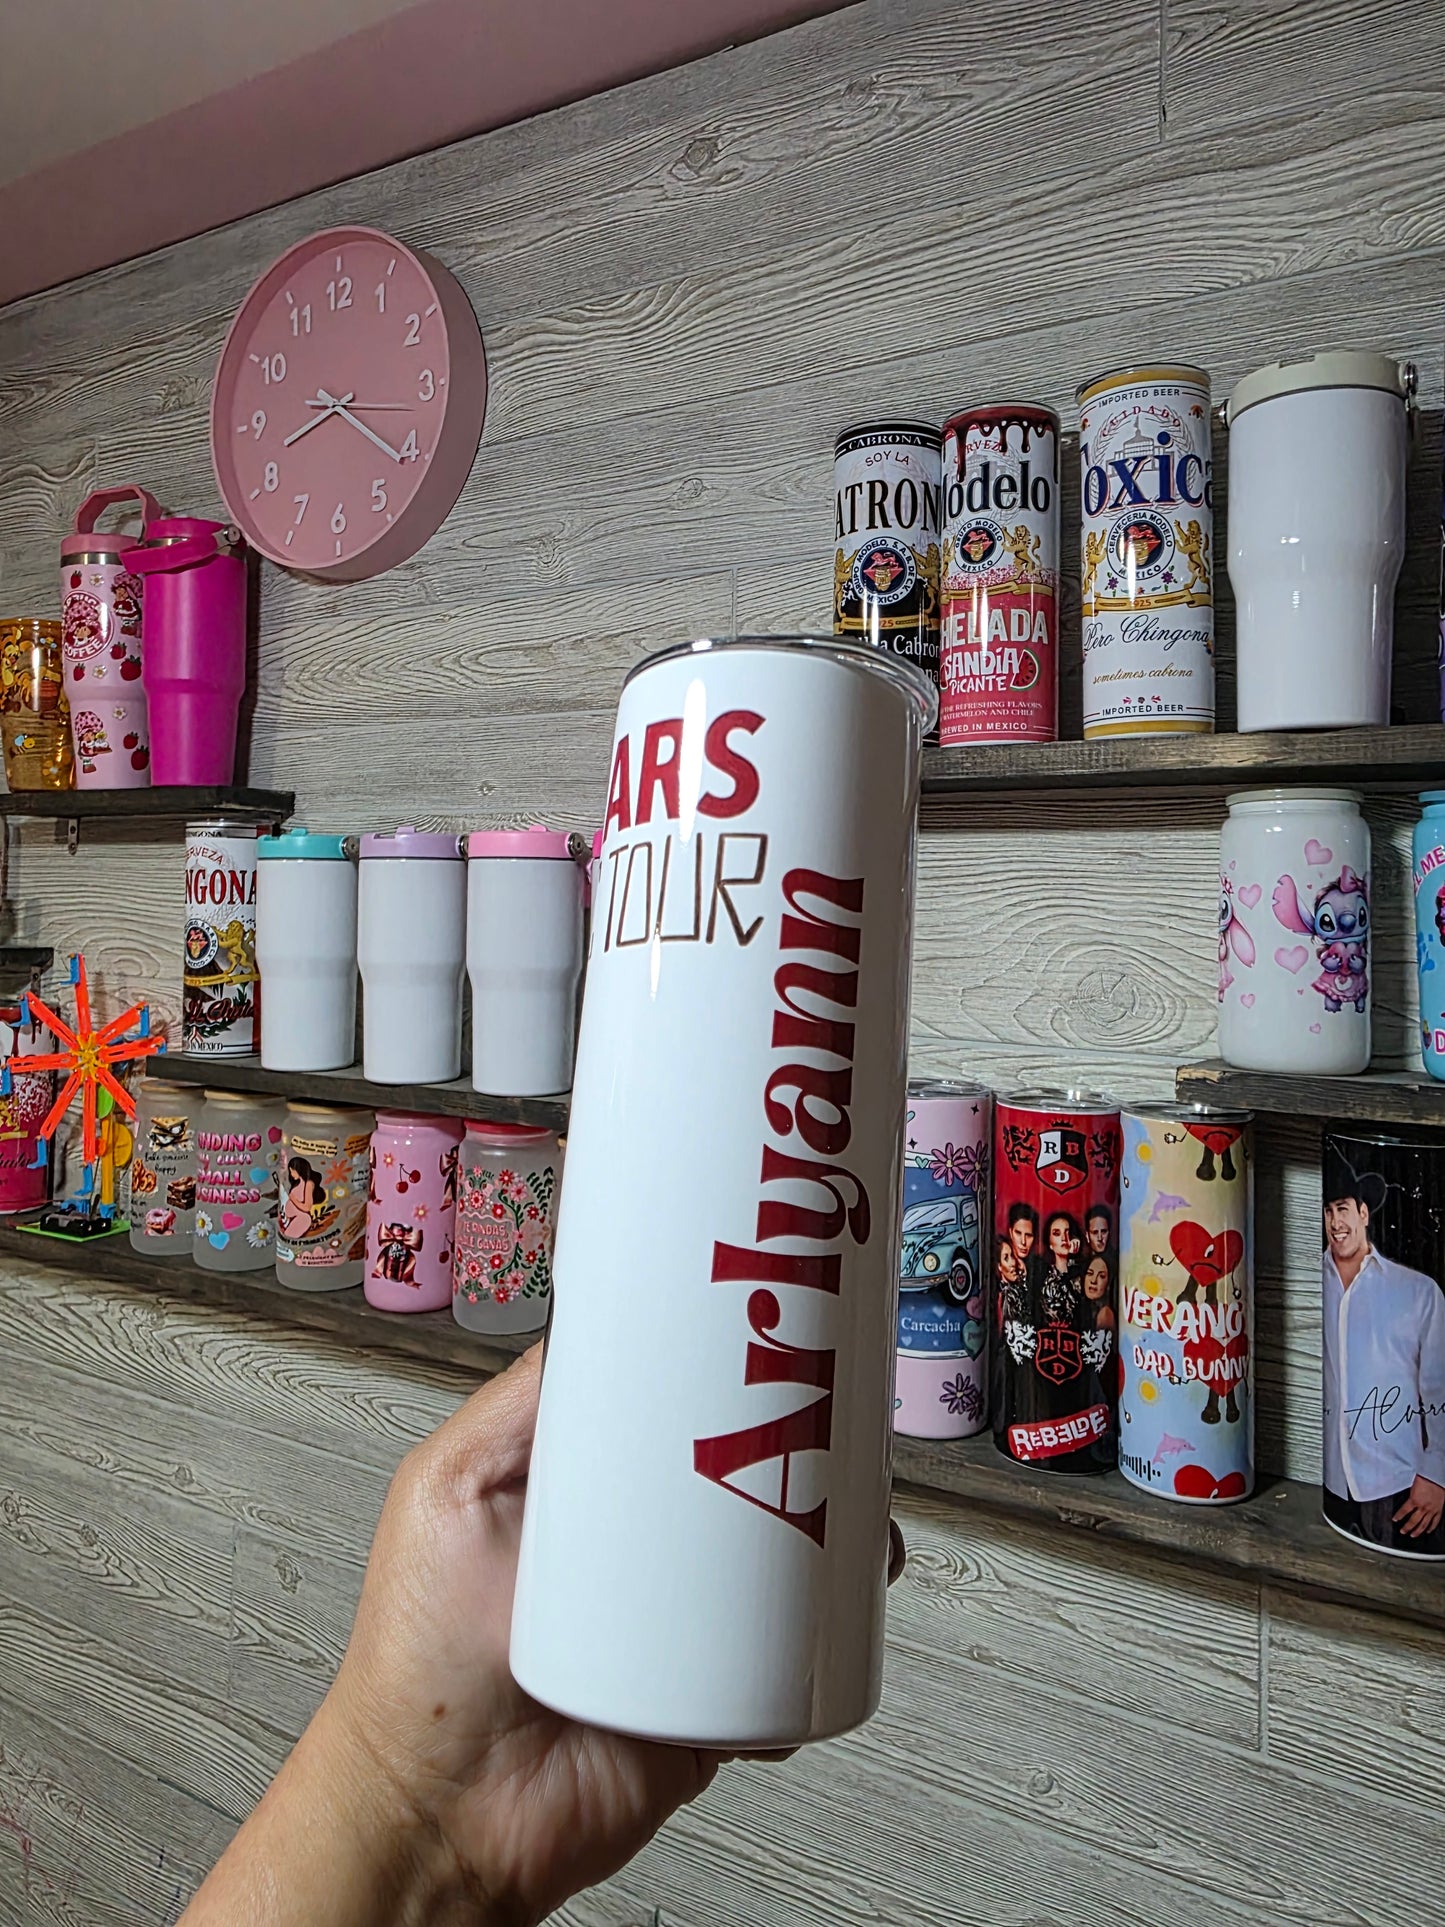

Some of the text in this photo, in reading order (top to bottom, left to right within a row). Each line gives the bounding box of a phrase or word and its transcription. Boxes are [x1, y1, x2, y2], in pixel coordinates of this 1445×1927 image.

[326, 277, 353, 311] 12
[374, 283, 386, 313] 1
[290, 304, 313, 336] 11
[402, 313, 422, 347] 2
[261, 352, 288, 384] 10
[418, 369, 435, 401] 3
[1099, 388, 1180, 408] IMPORTED BEER
[251, 409, 267, 440] 9
[400, 429, 421, 461] 4
[849, 434, 922, 449] CABRONA
[865, 450, 910, 467] SOY LA
[263, 461, 280, 492] 8
[294, 493, 310, 524] 7
[371, 479, 388, 512] 5
[330, 503, 347, 534] 6
[975, 520, 1003, 542] MODELO
[1108, 511, 1174, 554] CERVECERIA MODELO
[961, 560, 993, 571] MEXICO
[1118, 564, 1161, 579] MXICO
[1083, 614, 1210, 652] Pero Chingona
[1093, 662, 1194, 685] sometimes cabrona
[990, 708, 1009, 716] AND
[1102, 705, 1152, 716] IMPORTED
[986, 722, 1027, 731] MEXICO
[1043, 1141, 1058, 1155] R
[1054, 1169, 1070, 1184] D
[693, 867, 871, 1550] Arlyann
[901, 1316, 961, 1334] Carcacha
[1121, 1285, 1243, 1344] VERANO
[1182, 1356, 1249, 1381] BUNNY
